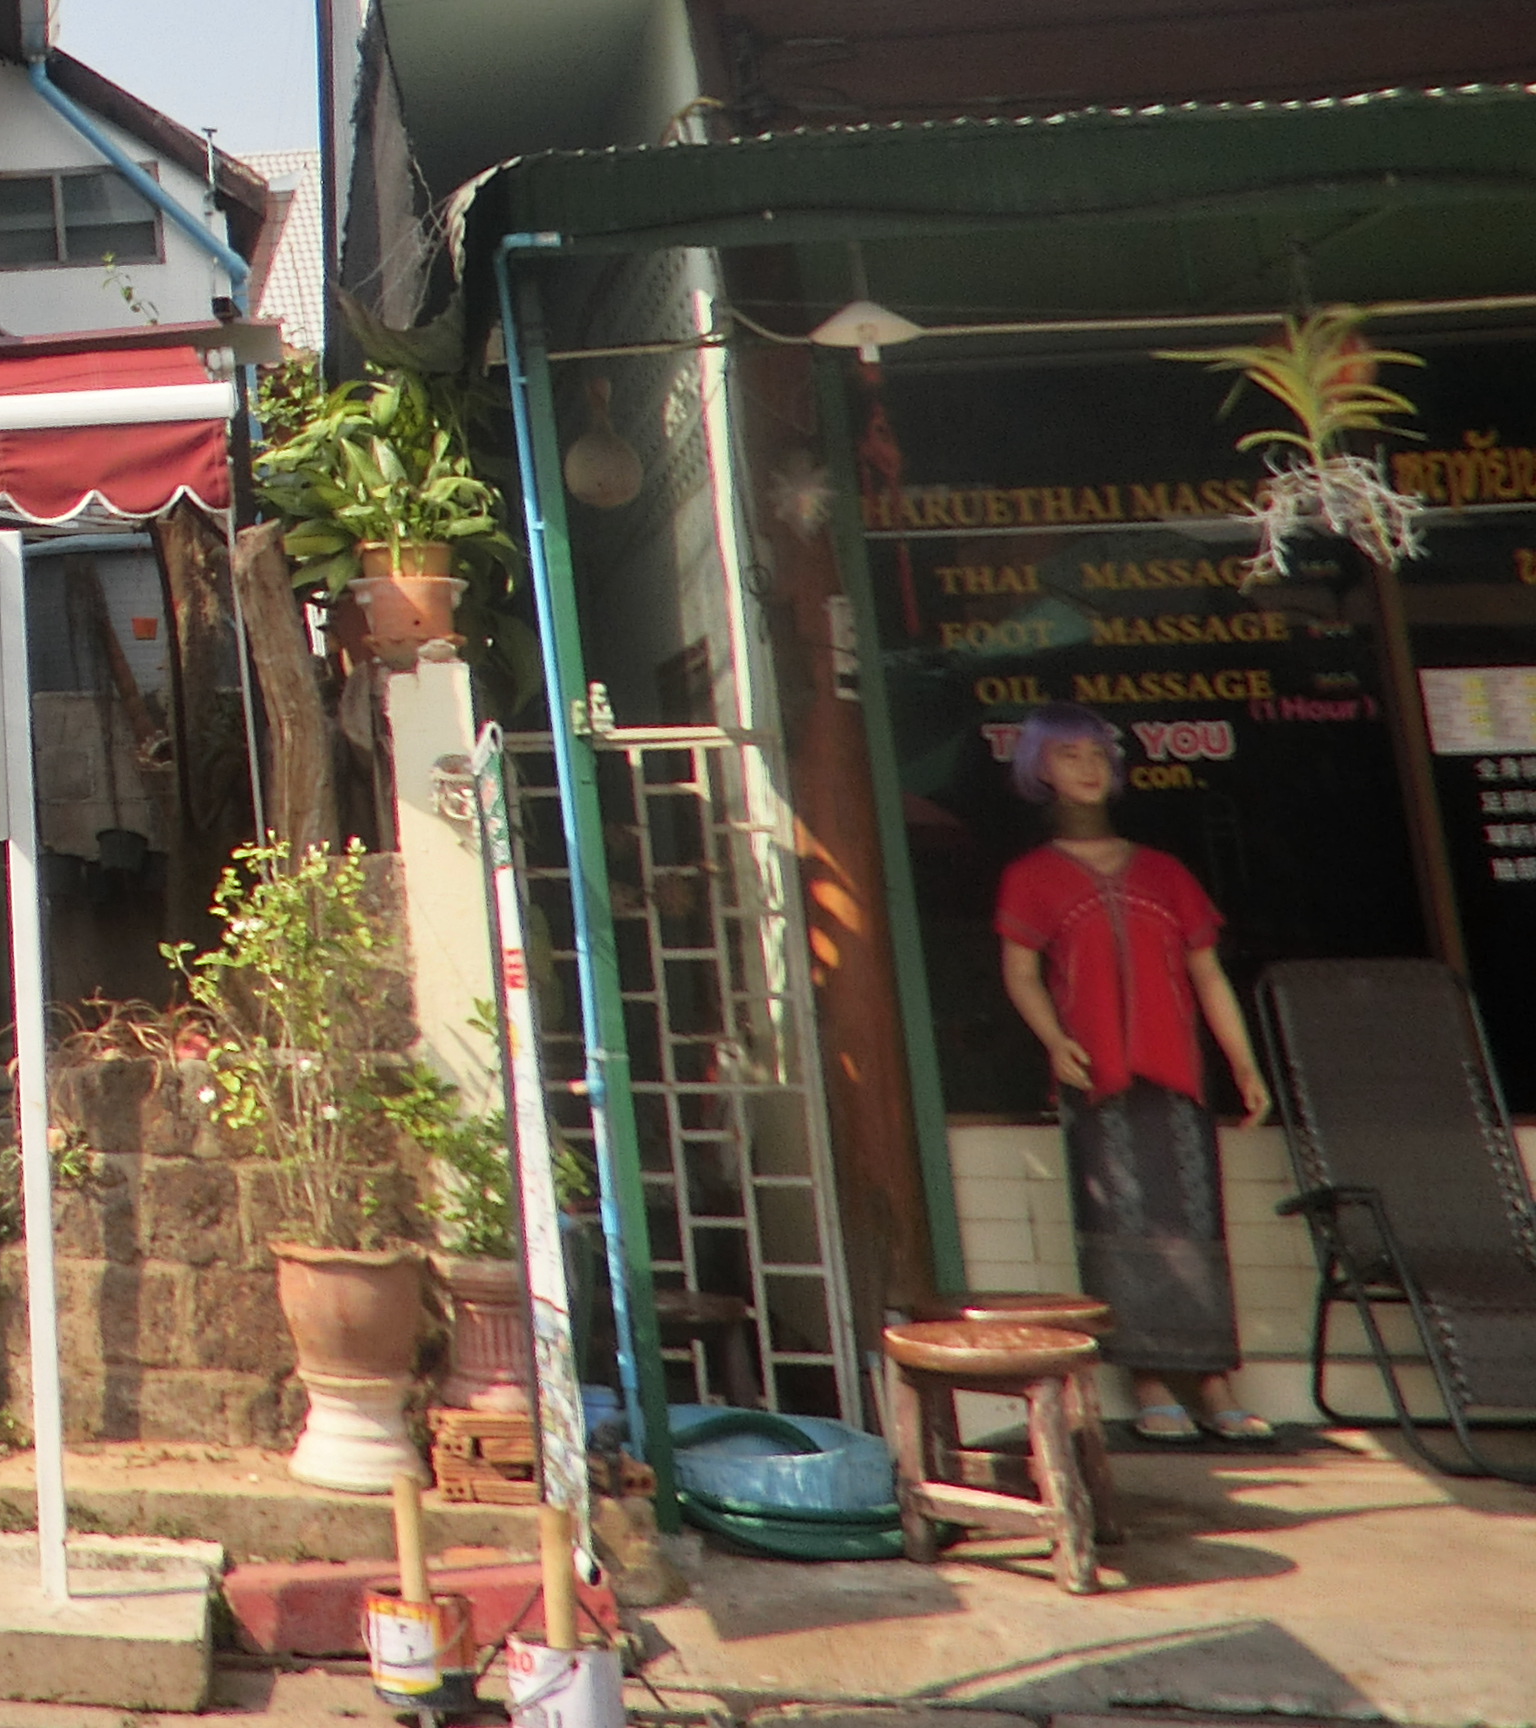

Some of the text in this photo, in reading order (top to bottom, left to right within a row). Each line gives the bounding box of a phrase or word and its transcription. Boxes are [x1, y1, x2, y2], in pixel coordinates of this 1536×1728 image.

[864, 483, 1123, 529] HARUETHAI
[940, 565, 1041, 595] THAI
[939, 619, 1055, 650] FOOT
[1091, 612, 1290, 646] MASSAGE
[973, 670, 1273, 706] OIL MASSAGE
[1132, 721, 1236, 761] YOU
